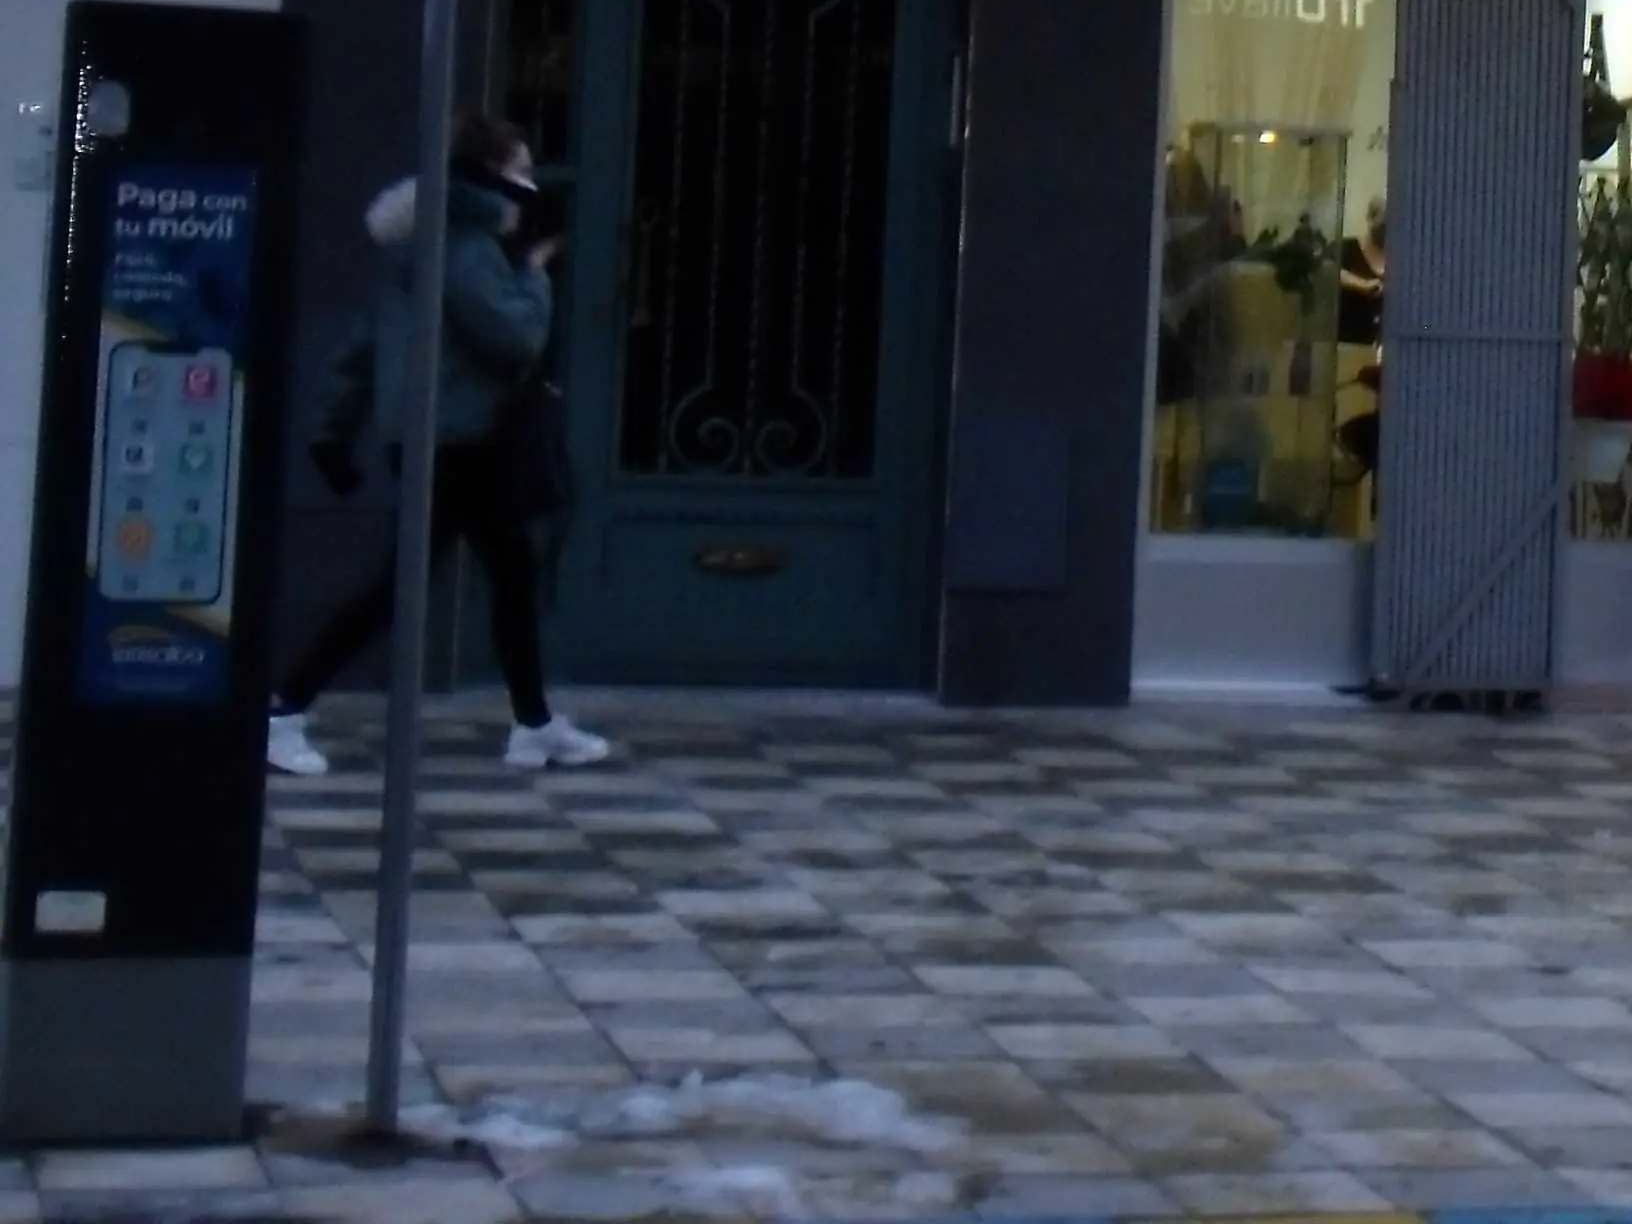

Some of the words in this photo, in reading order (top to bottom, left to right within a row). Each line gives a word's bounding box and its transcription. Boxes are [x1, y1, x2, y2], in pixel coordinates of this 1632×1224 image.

[116, 181, 197, 214] Paga
[203, 193, 248, 212] con
[114, 216, 142, 240] tu
[147, 213, 235, 241] móvil
